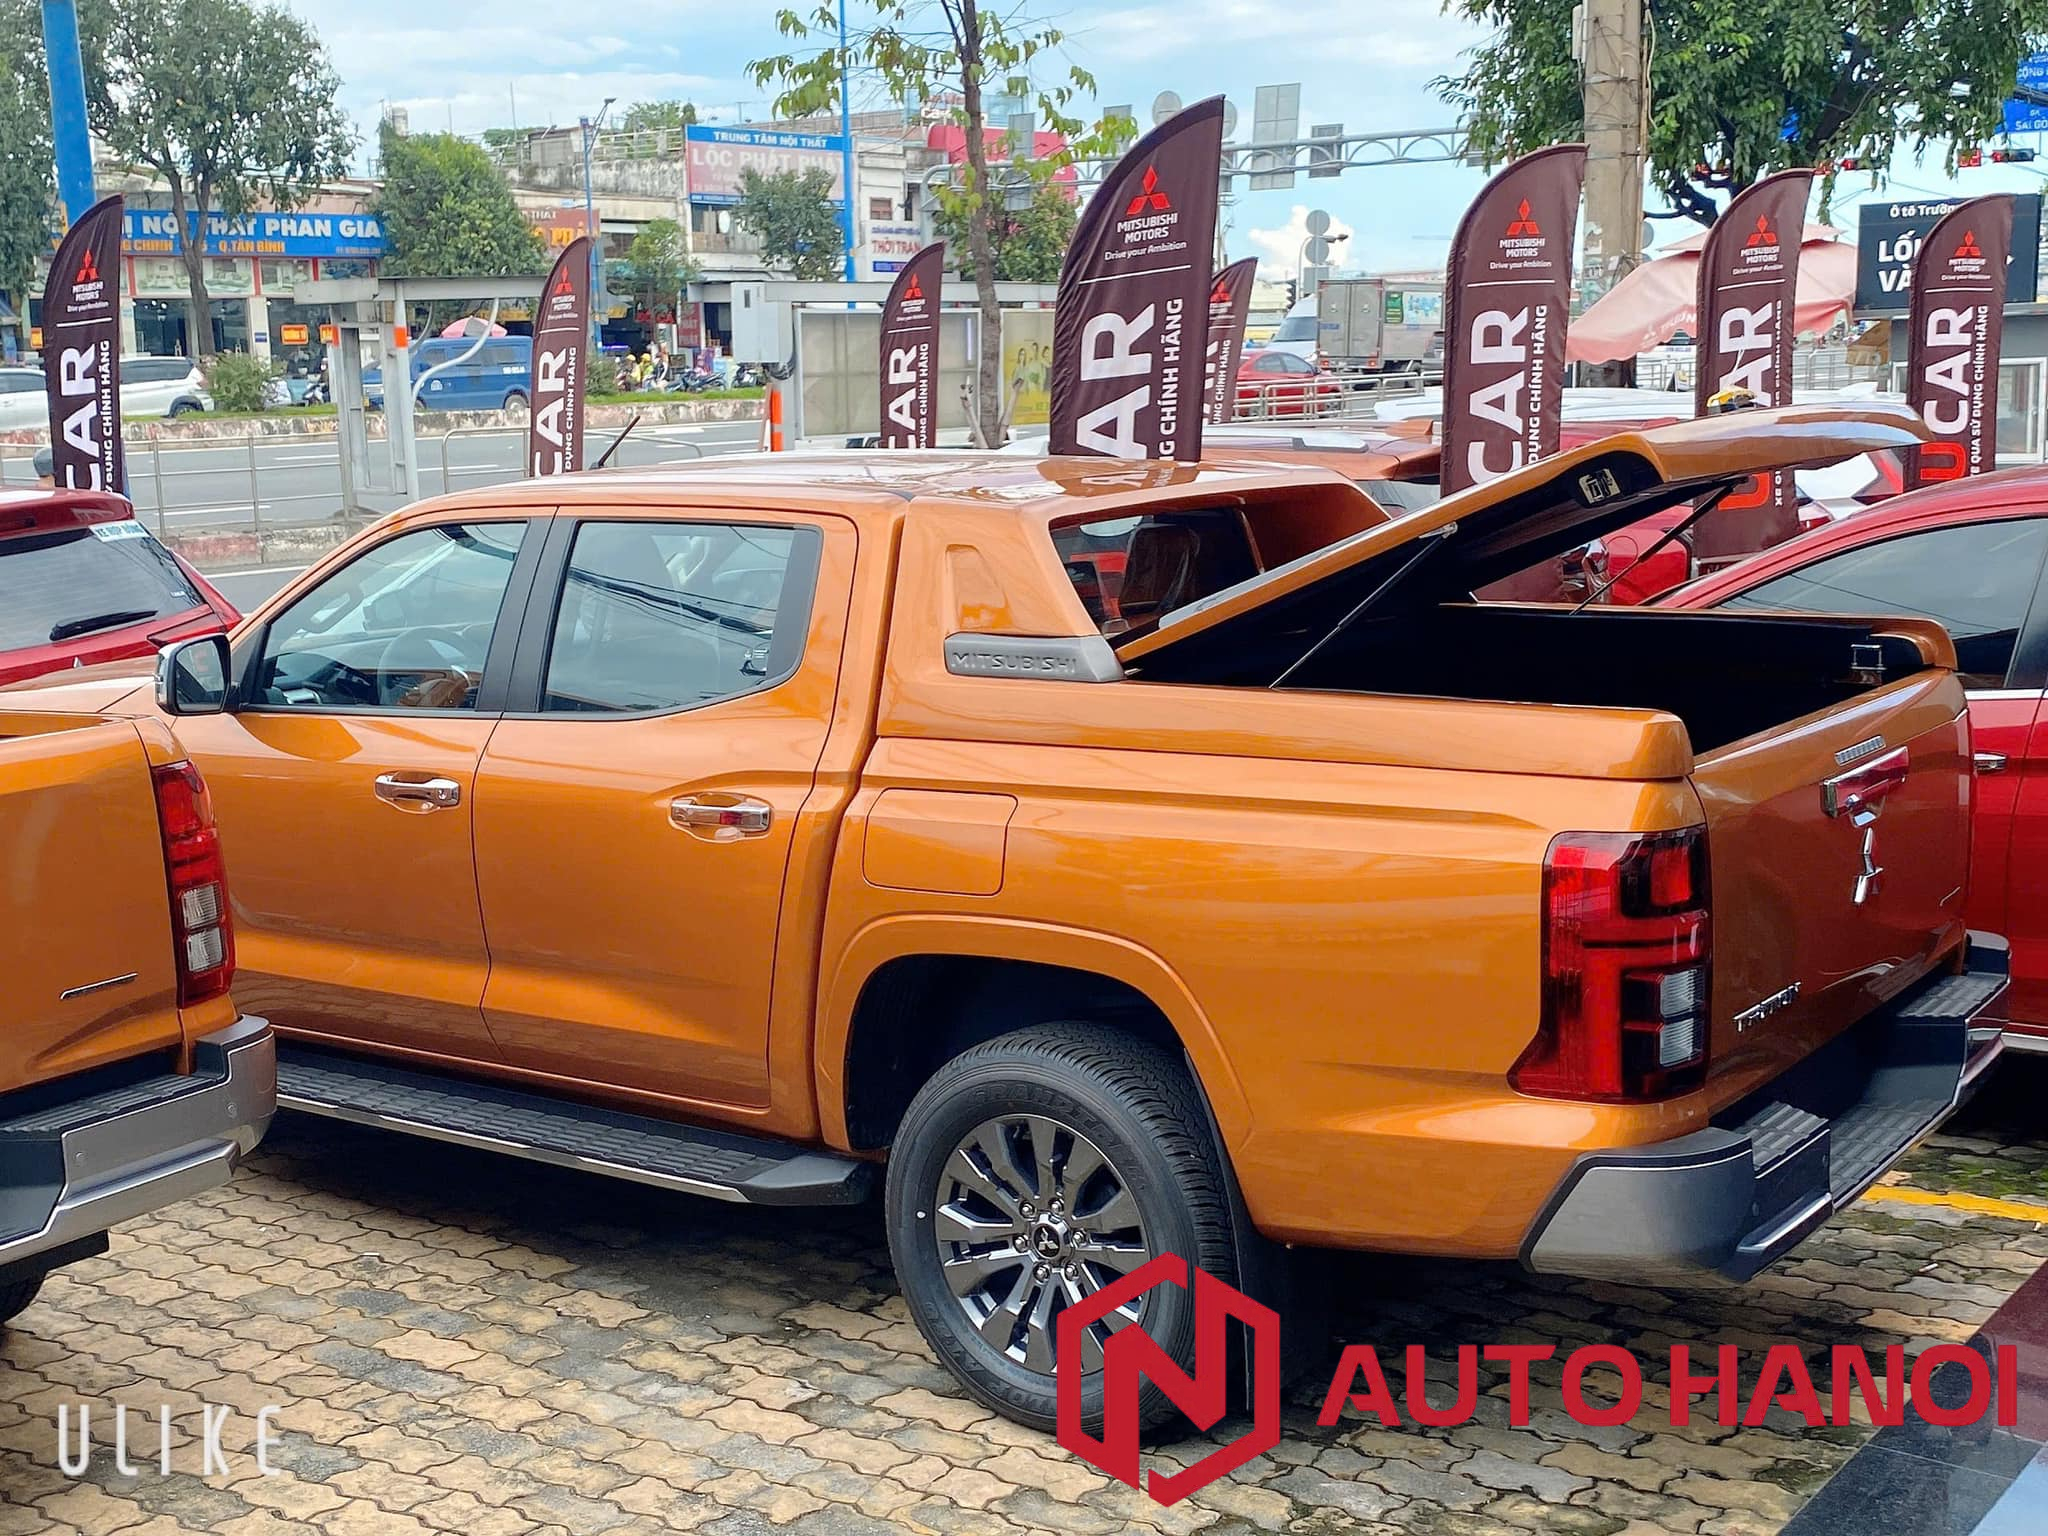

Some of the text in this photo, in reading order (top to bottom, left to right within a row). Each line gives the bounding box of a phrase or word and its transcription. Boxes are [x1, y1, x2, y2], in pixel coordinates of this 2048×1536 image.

[713, 131, 828, 148] TRUNG TÂM NỘI THẤT
[692, 144, 734, 170] LỘC
[1117, 213, 1178, 233] MITSUBISHI
[1890, 203, 1899, 218] Ô
[1901, 205, 1916, 217] tô
[142, 212, 184, 240] NỘ
[265, 217, 332, 238] PHAN
[339, 219, 381, 239] GIA
[1124, 227, 1169, 244] MOTORS
[1104, 241, 1187, 261] Drive your Ambition
[1499, 238, 1546, 249] MITSUBISHI
[1506, 247, 1539, 258] MOTORS
[1746, 254, 1778, 264] MOTORS
[1160, 298, 1183, 362] HÃNG
[1531, 304, 1547, 355] HÃNG
[1974, 305, 1989, 341] HÃNG
[1973, 343, 1987, 381] CHÍNH
[1467, 306, 1529, 485] CAR
[1528, 359, 1543, 413] CHÍNH
[100, 388, 113, 437] CHÍNH
[534, 348, 567, 478] CAR
[565, 389, 574, 429] CHÍNH
[1157, 367, 1179, 436] CHÍNH
[60, 344, 101, 492] CAR
[1970, 438, 1983, 465] QUA
[951, 652, 1078, 674] MITSUBISHI
